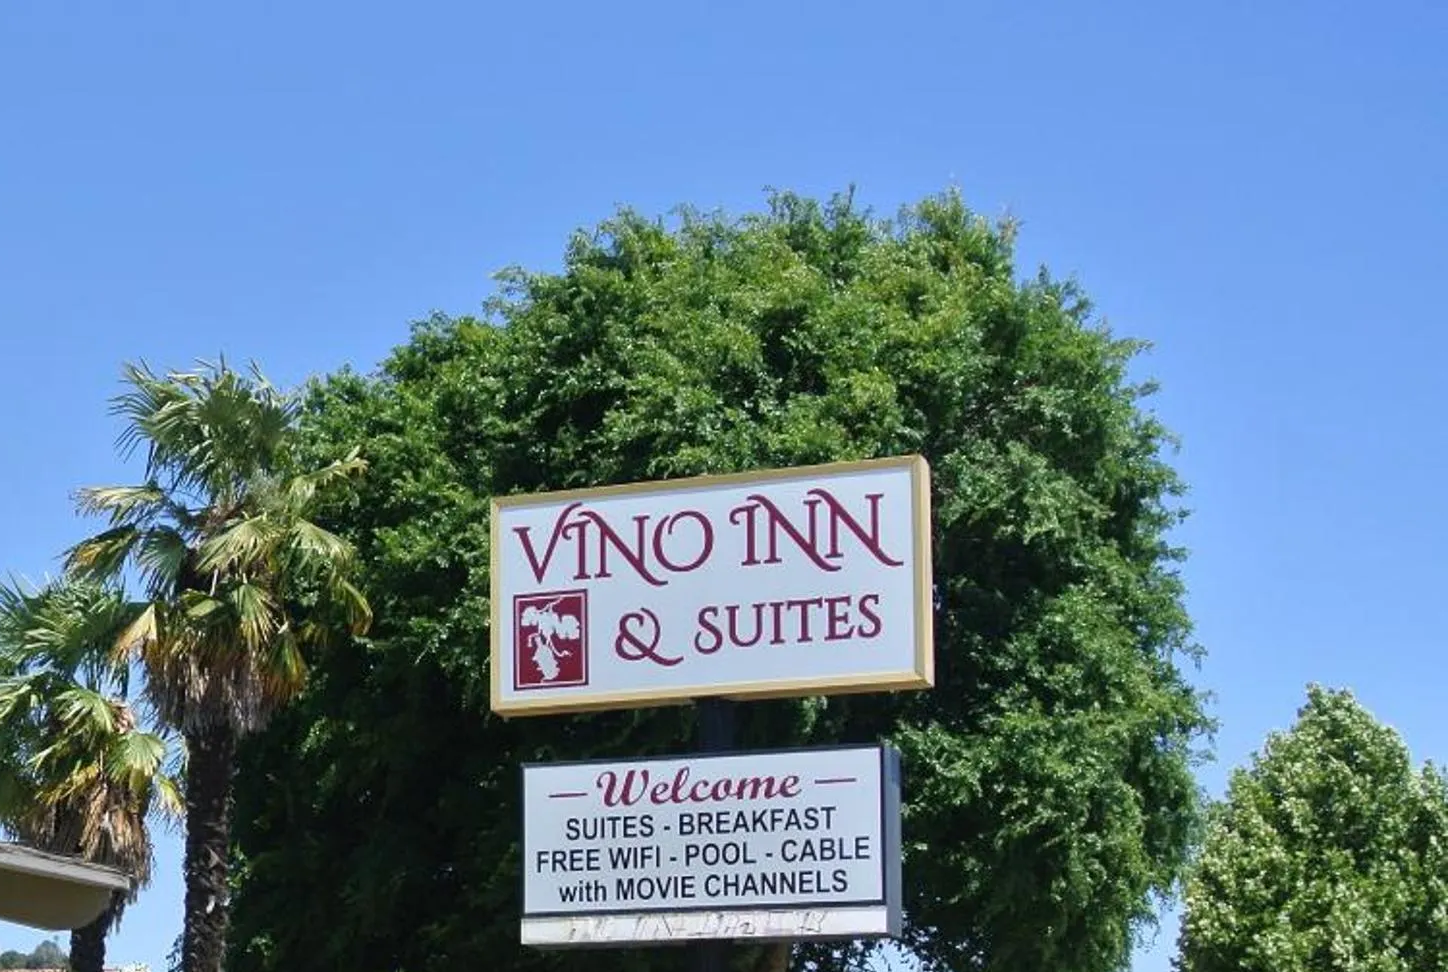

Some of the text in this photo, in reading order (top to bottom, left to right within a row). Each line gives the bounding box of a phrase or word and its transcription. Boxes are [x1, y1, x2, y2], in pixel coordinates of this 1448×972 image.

[512, 488, 904, 586] VINO INN
[614, 594, 882, 666] & SUITES
[596, 766, 803, 807] Welcome
[566, 814, 654, 840] SUITES
[679, 806, 837, 836] BREAKFAST
[537, 848, 600, 873] FREE
[609, 845, 661, 870] WIFI
[685, 842, 756, 867] POOL
[781, 837, 871, 862] CABLE
[559, 869, 848, 902] with MOVIE CHANNELS
